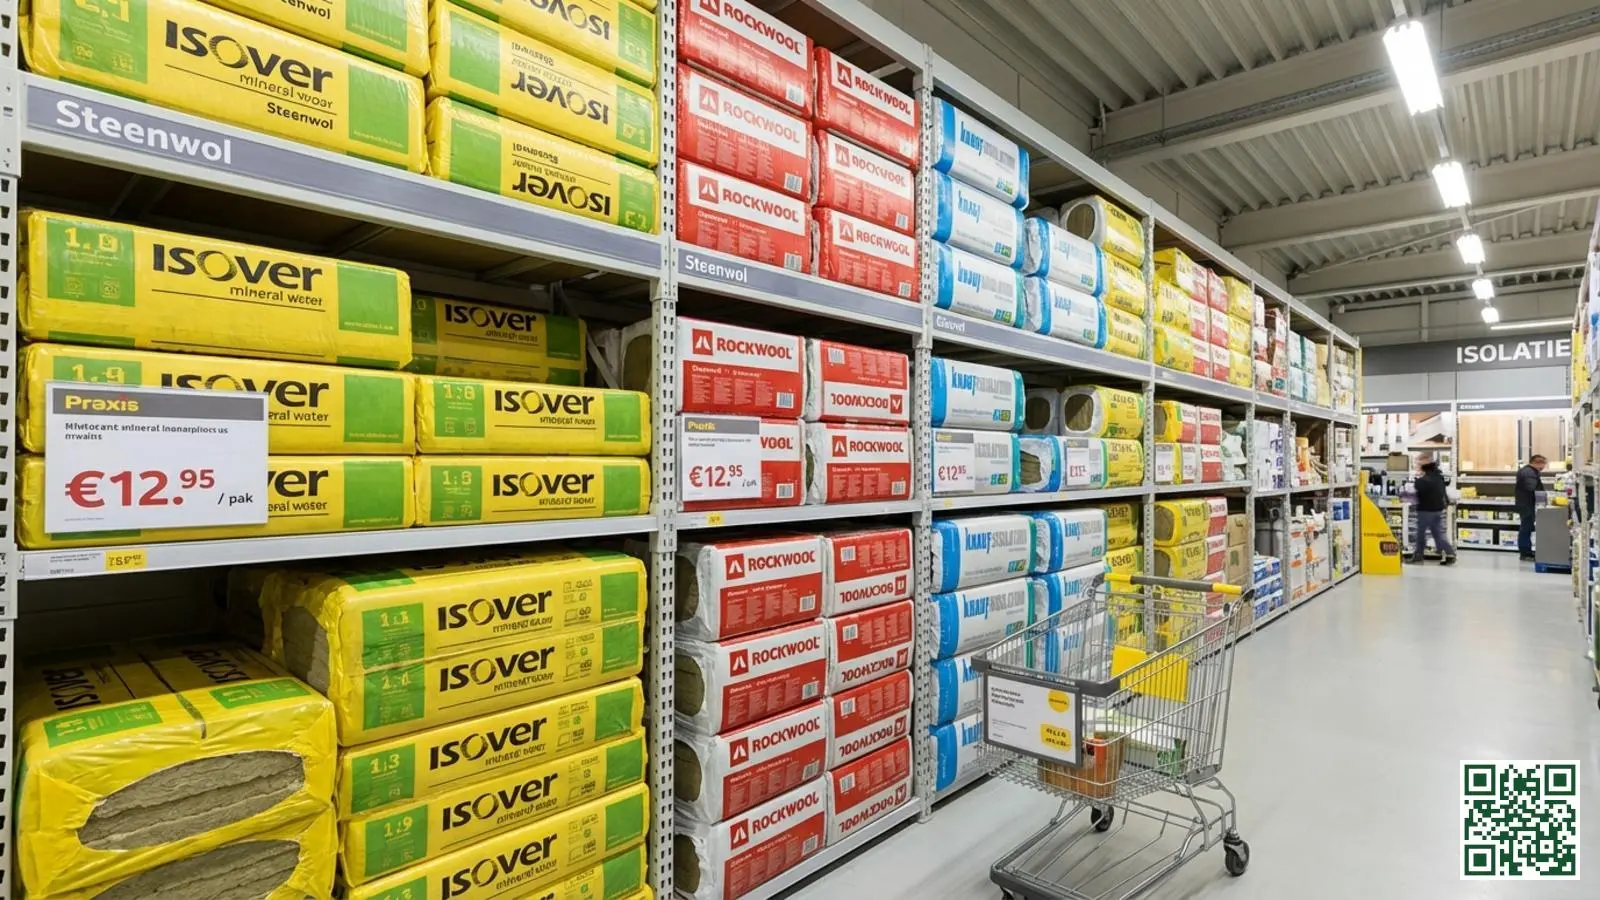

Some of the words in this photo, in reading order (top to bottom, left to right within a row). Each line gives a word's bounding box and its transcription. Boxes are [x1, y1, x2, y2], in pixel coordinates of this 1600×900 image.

[266, 101, 333, 130] Steenwol
[56, 99, 232, 165] Steenwol
[722, 187, 800, 223] ROCKWOOL
[684, 254, 749, 284] Steenwol
[716, 337, 793, 360] ROCKWOOL
[1456, 338, 1572, 365] ISOLATIE
[229, 493, 254, 506] pak
[752, 637, 819, 666] ROCKWOOL
[752, 720, 819, 753] ROCKWOOL
[752, 792, 820, 836] ROCKWOOL
